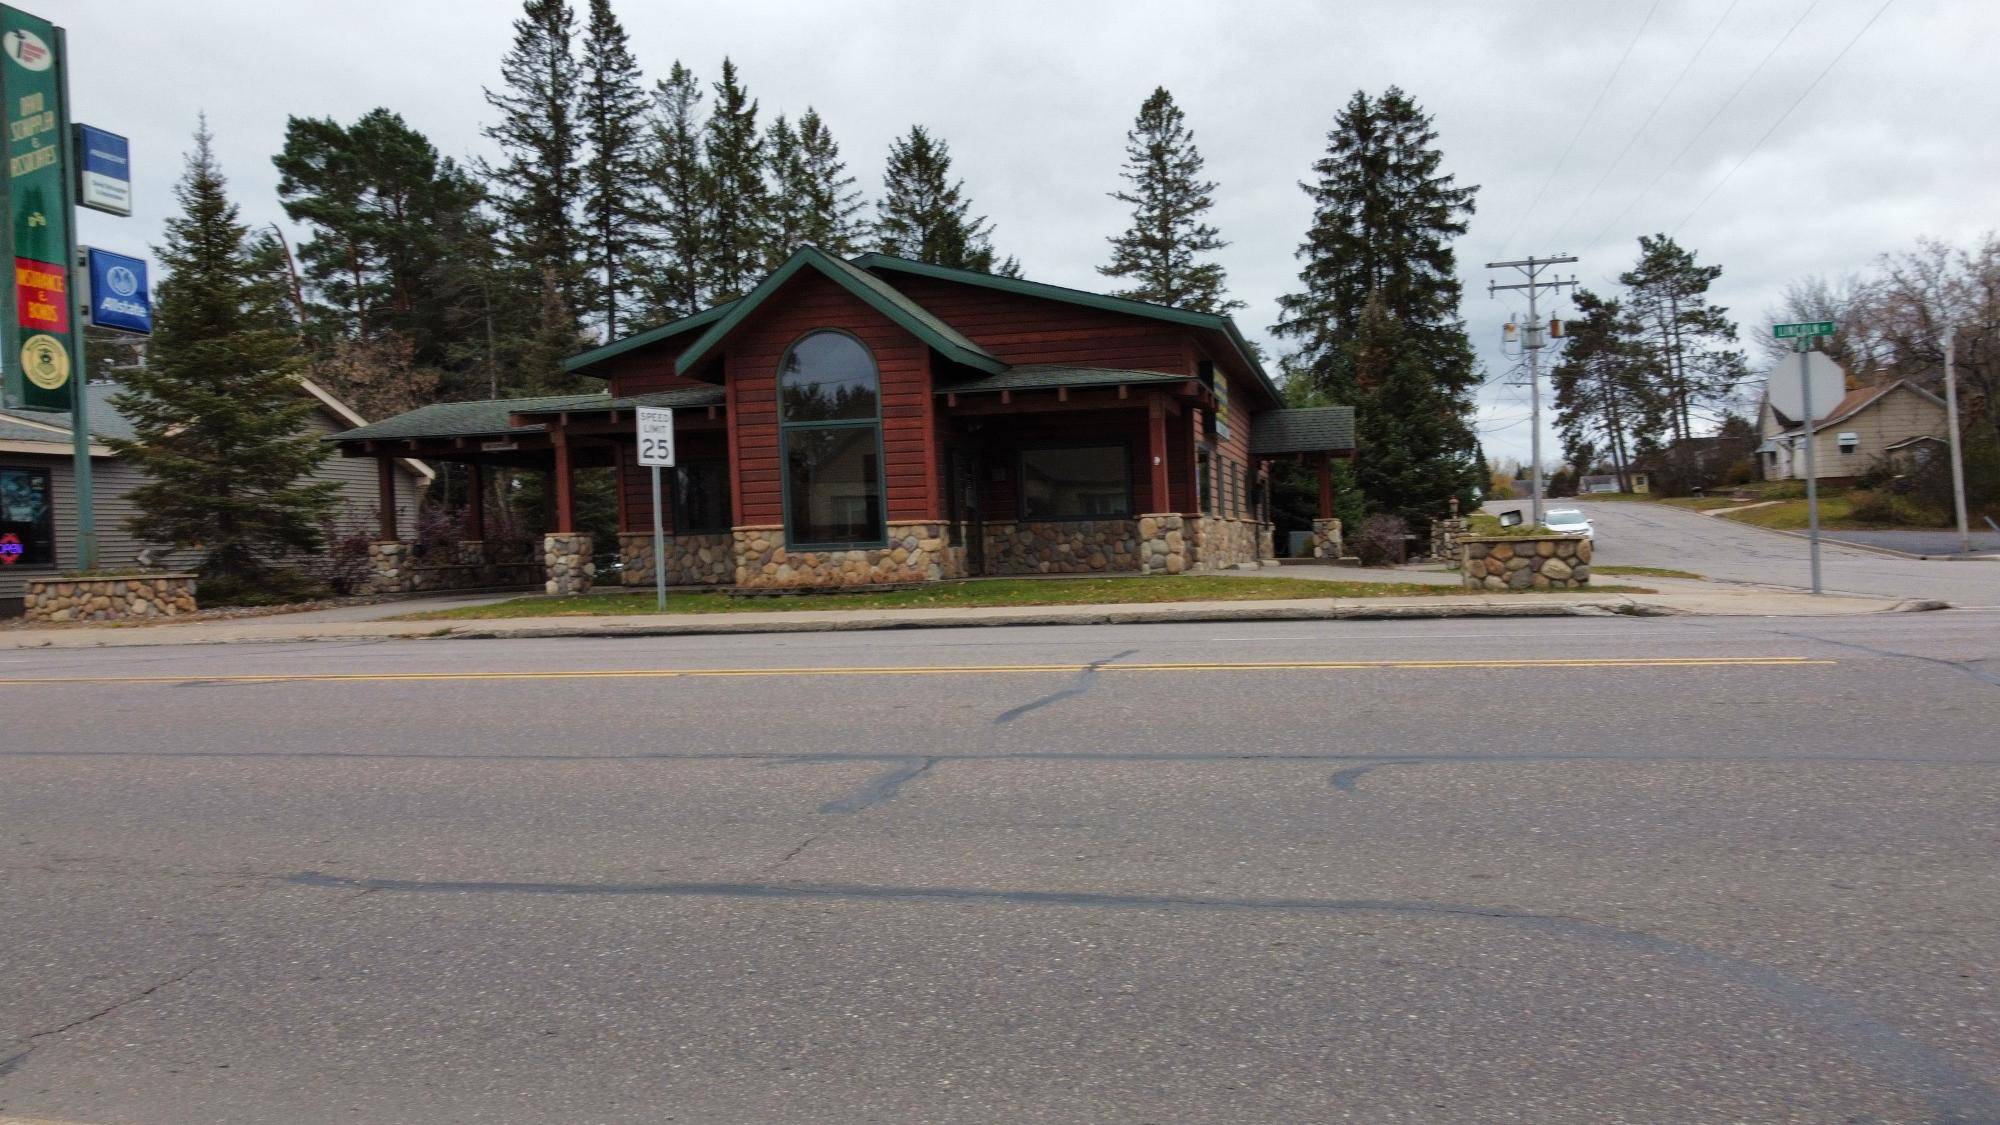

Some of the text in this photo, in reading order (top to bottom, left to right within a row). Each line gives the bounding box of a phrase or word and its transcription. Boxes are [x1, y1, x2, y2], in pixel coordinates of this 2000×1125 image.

[100, 297, 147, 317] Allstate
[640, 412, 670, 423] SPEED
[643, 425, 667, 433] LIMIT
[642, 438, 670, 460] 25
